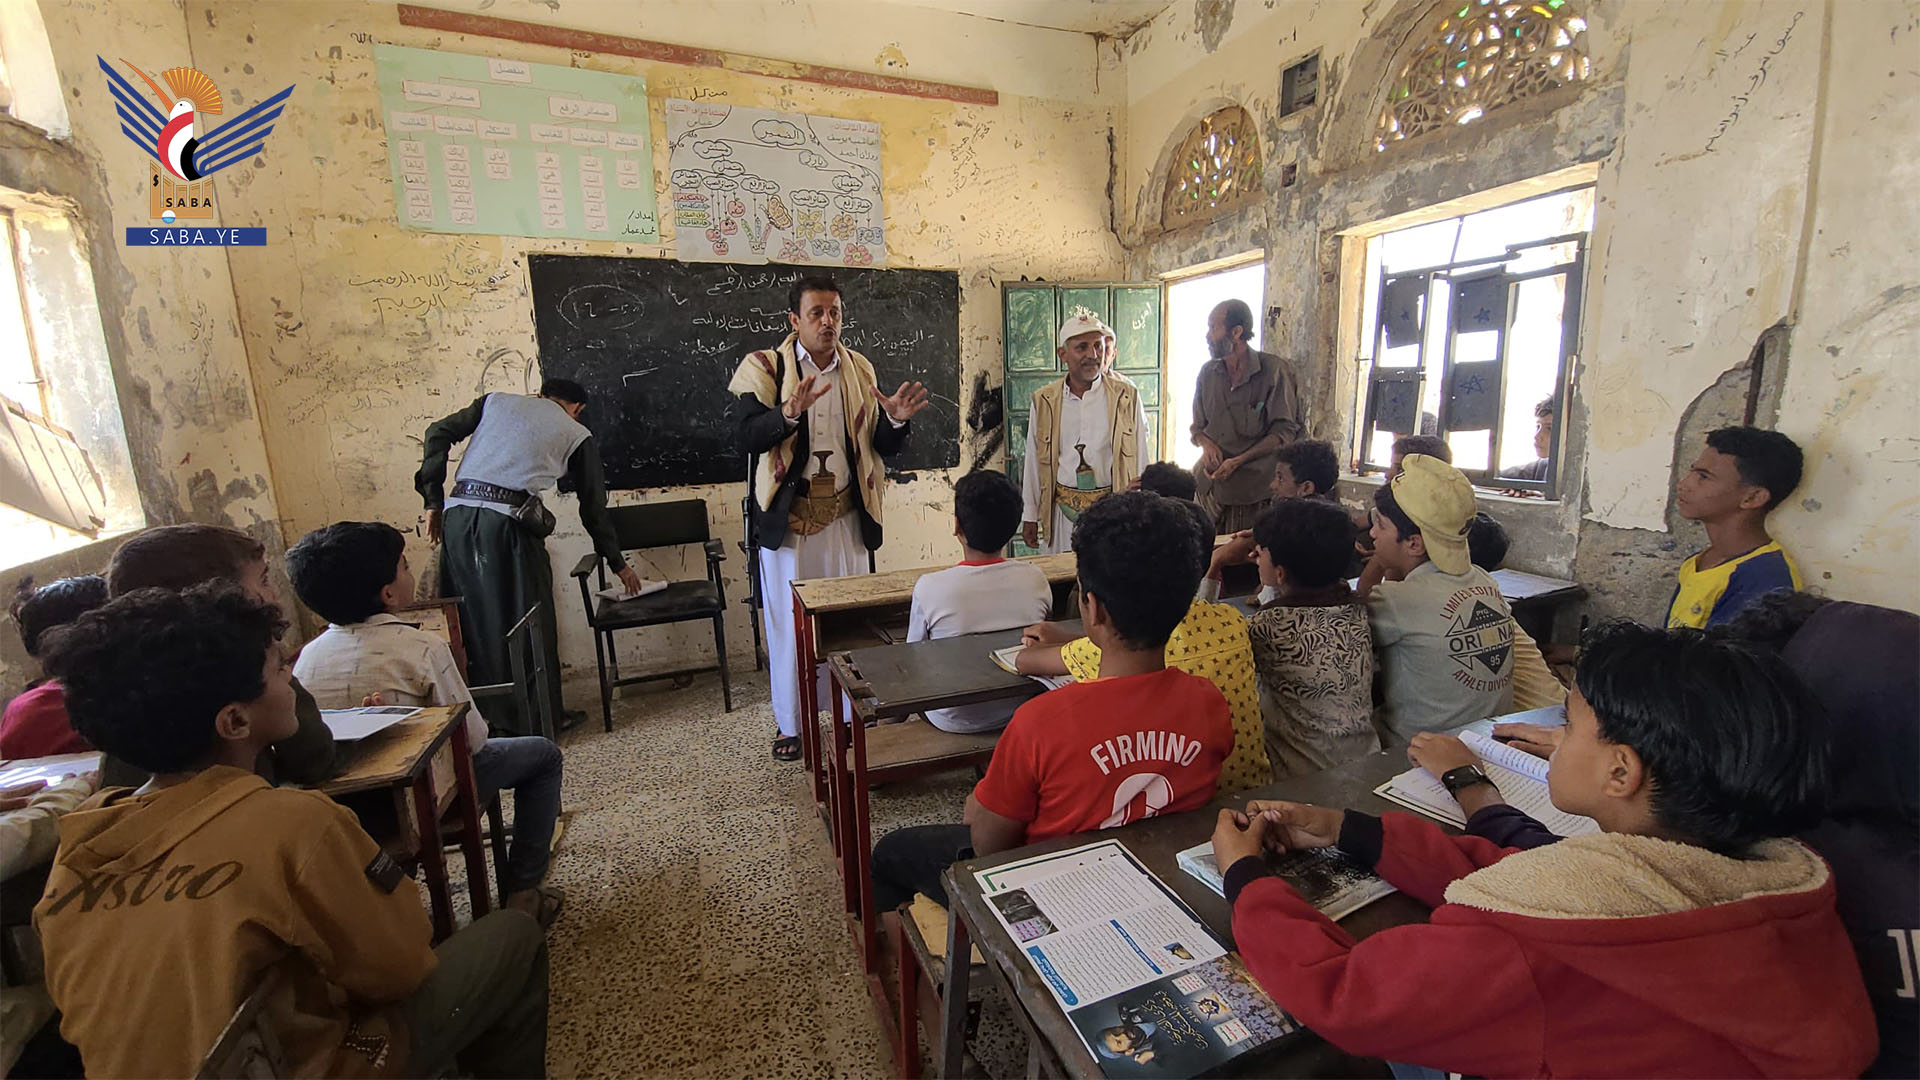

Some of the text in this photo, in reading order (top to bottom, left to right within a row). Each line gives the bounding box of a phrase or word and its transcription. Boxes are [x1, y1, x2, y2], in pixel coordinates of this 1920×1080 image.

[760, 129, 800, 140] الضمير
[1490, 654, 1501, 666] 95
[1090, 730, 1202, 776] FIRMINO
